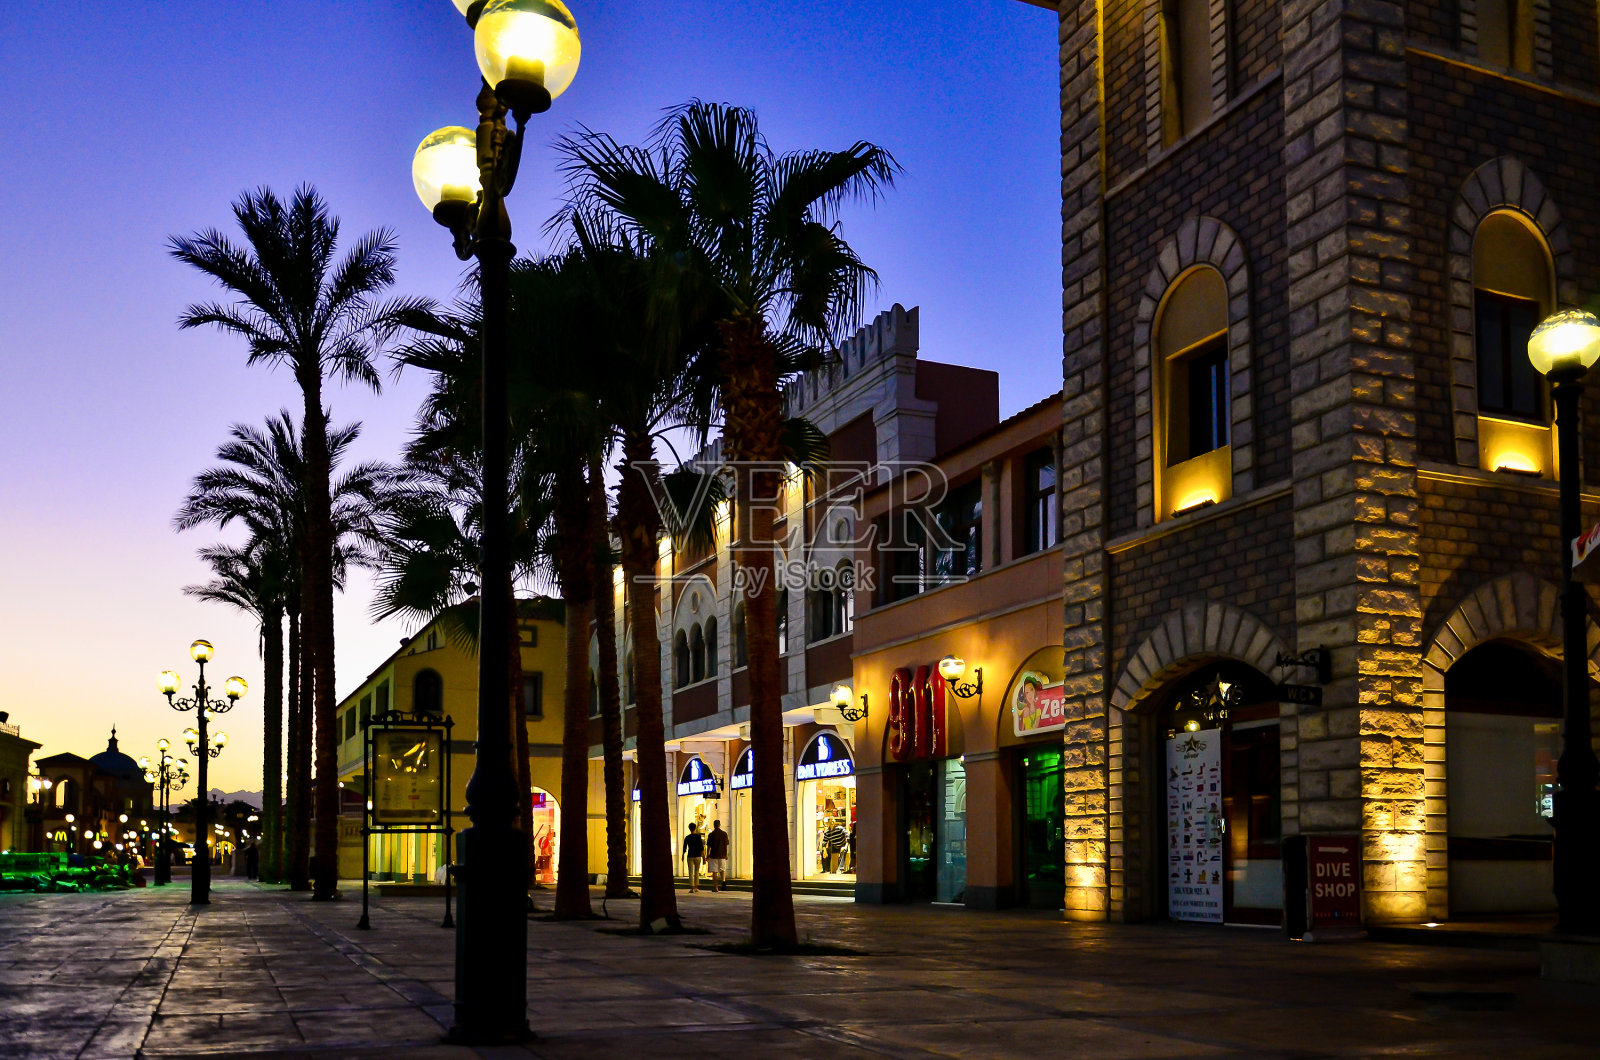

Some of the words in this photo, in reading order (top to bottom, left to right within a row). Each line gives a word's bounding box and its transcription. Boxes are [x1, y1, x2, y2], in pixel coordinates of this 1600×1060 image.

[889, 662, 945, 761] 911
[1316, 862, 1352, 877] DIVE
[1315, 883, 1356, 898] SHOP
